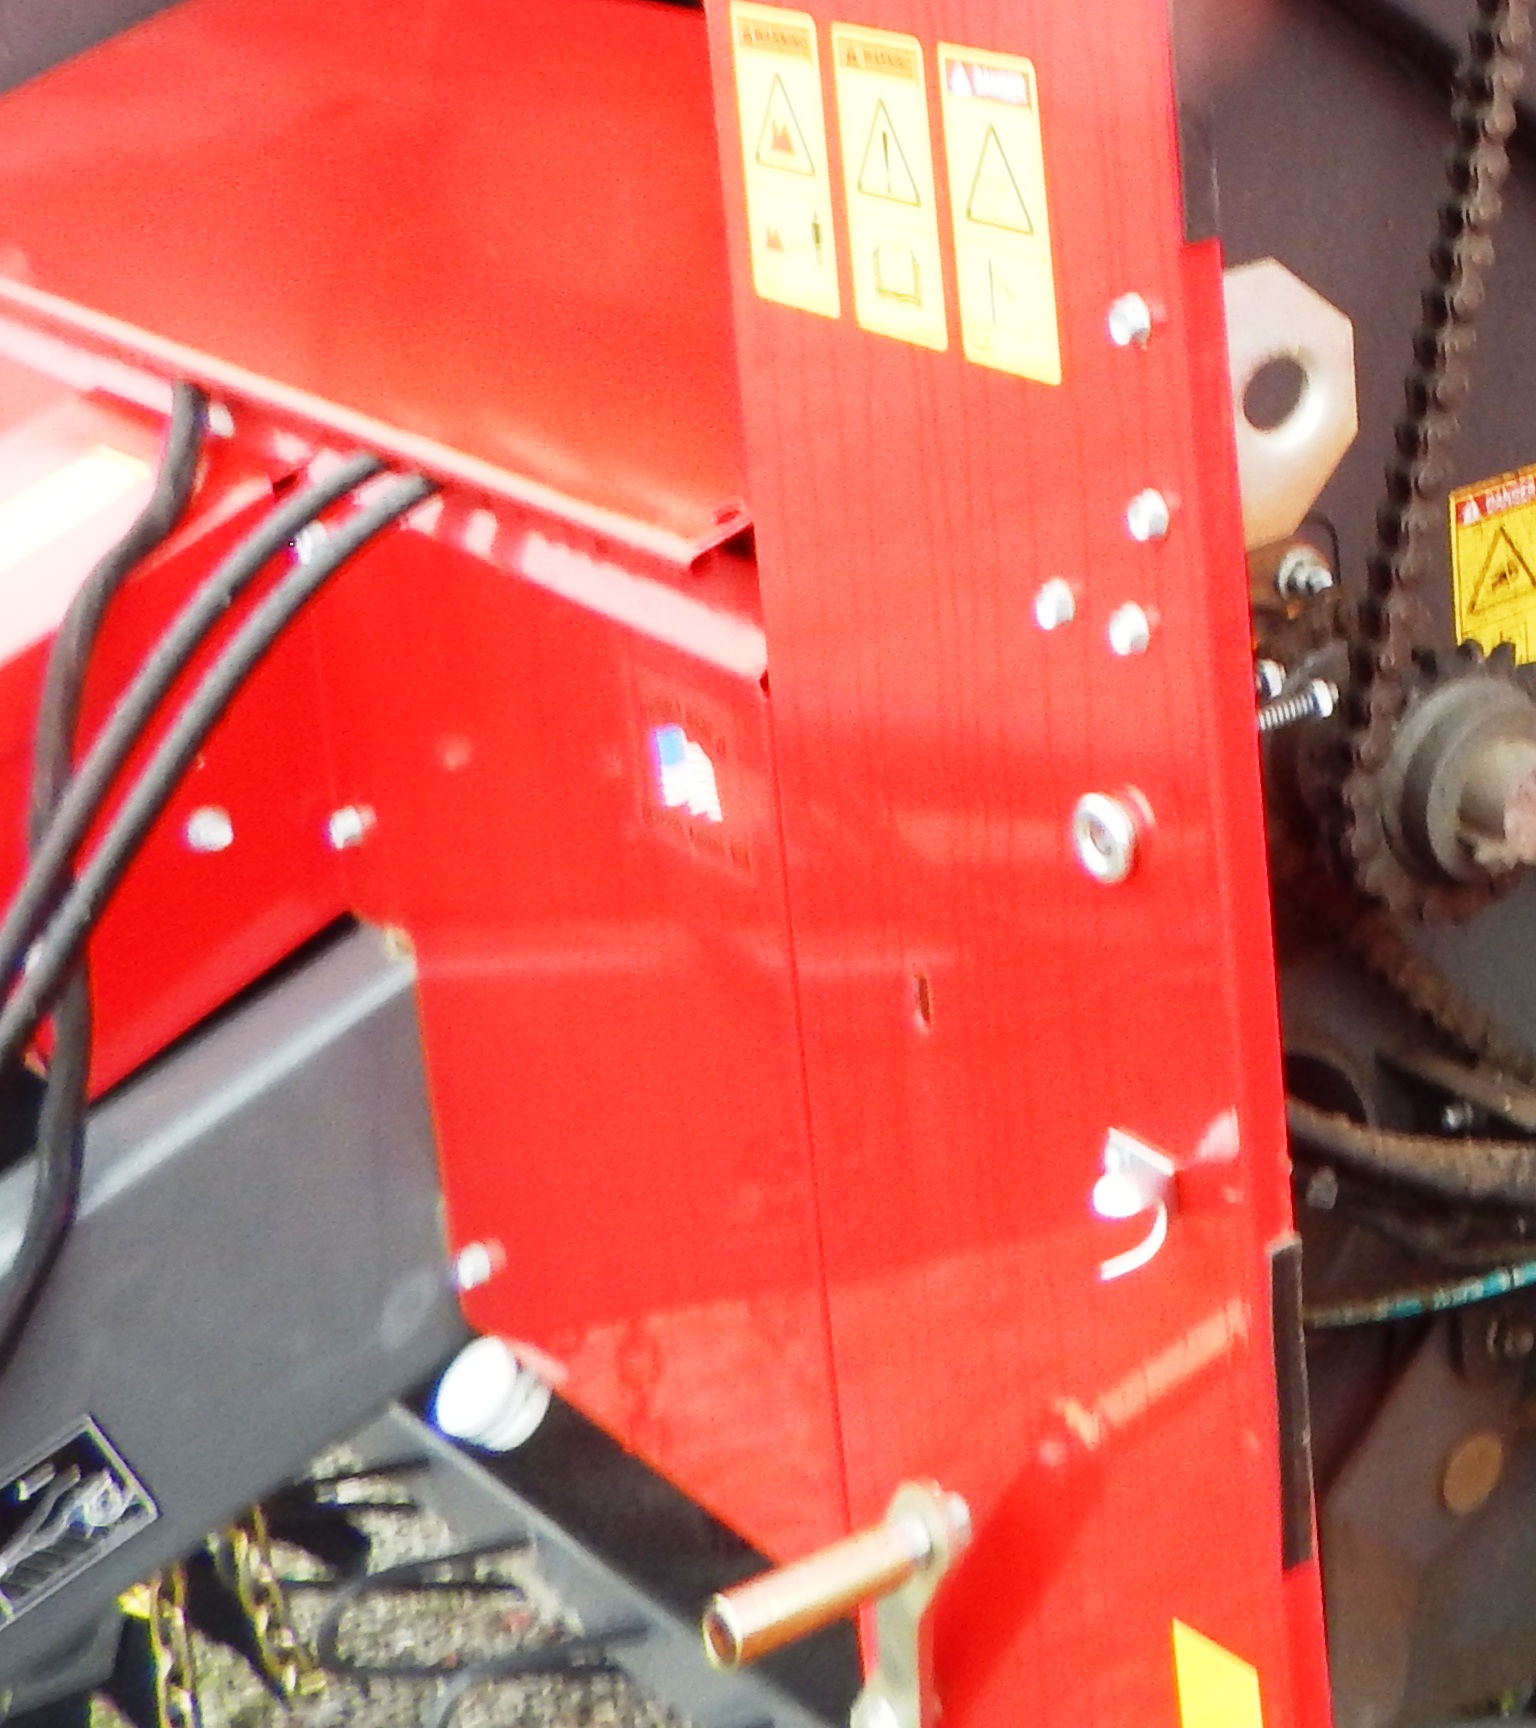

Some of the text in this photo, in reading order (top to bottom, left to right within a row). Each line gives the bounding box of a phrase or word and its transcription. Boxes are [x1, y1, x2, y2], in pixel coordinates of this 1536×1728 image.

[753, 28, 809, 51] WARNING
[863, 47, 913, 72] WARNING
[1485, 475, 1536, 514] DANGER
